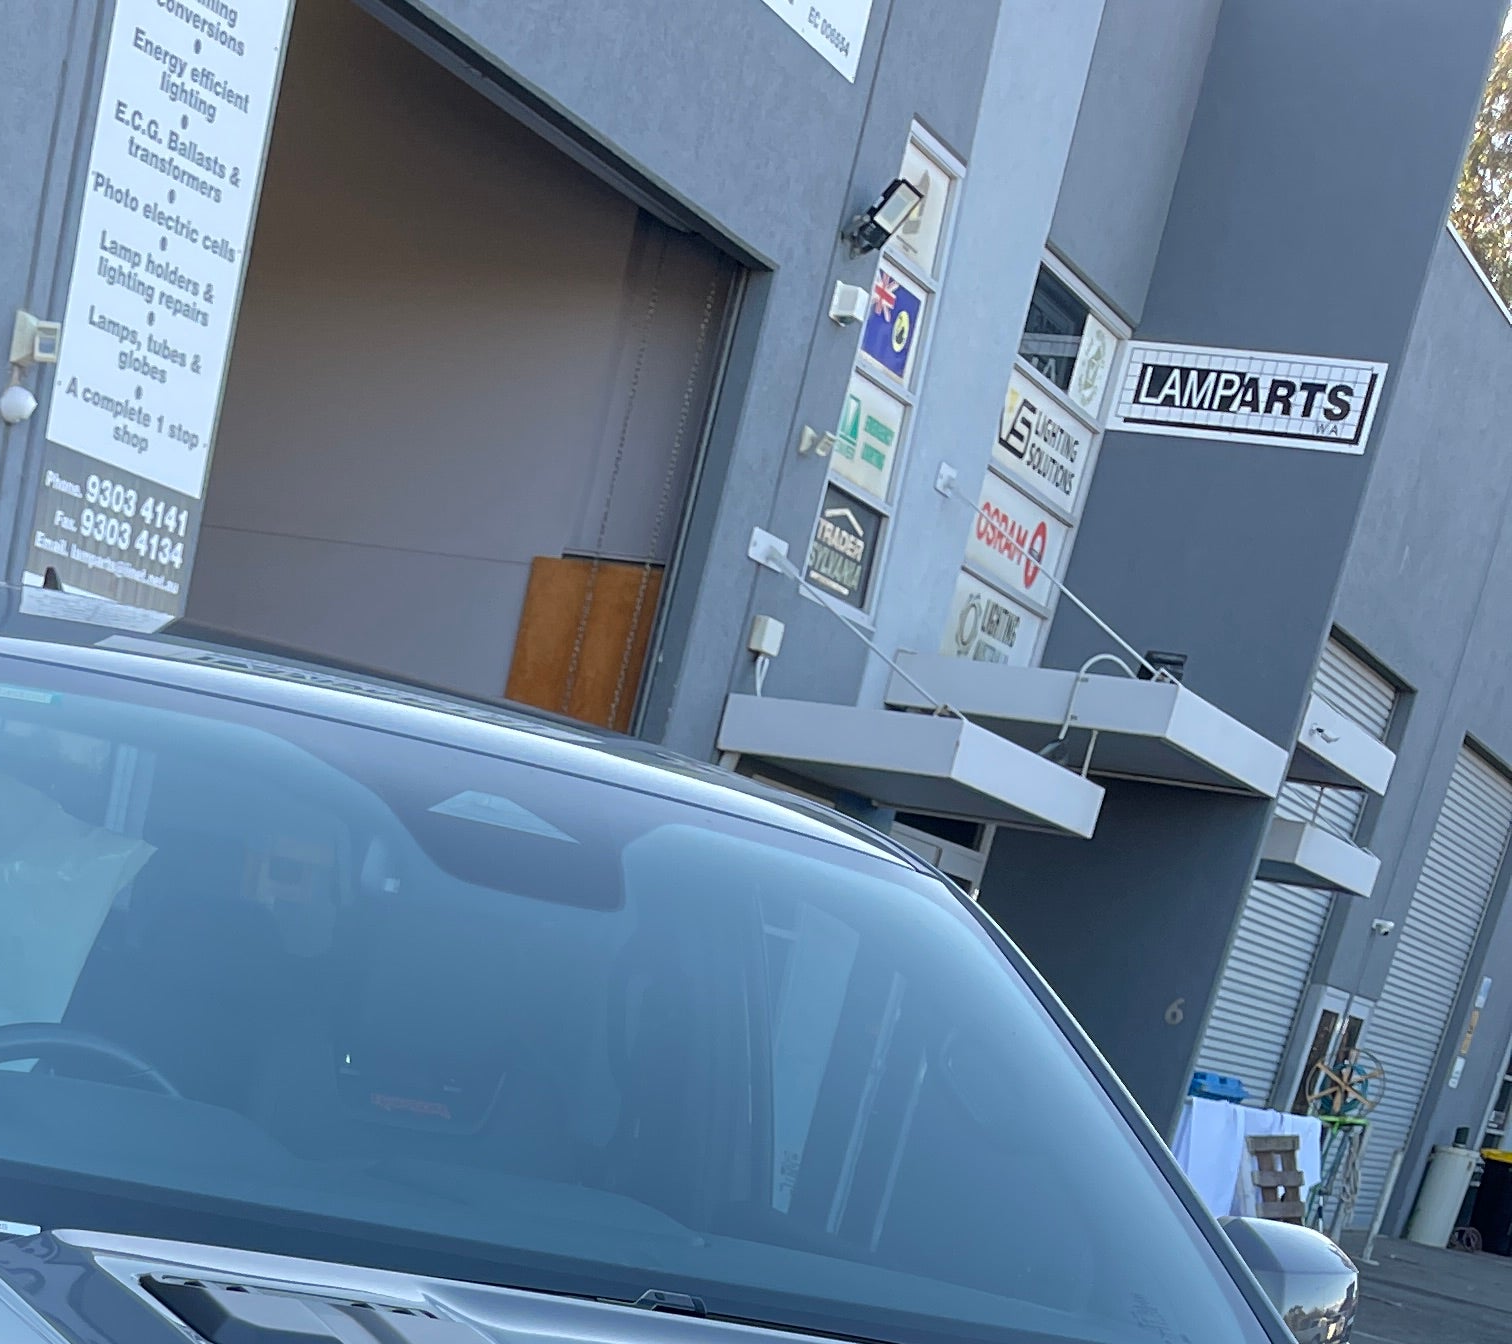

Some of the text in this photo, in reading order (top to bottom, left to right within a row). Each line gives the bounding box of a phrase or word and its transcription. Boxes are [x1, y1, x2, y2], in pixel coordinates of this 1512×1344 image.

[133, 27, 250, 114] Energy efficient
[159, 71, 217, 123] lighting
[114, 100, 241, 188] E.C.G. Ballasts &
[128, 136, 223, 203] transformers
[93, 173, 236, 263] Photo electric cells
[97, 255, 209, 327] lighting repairs
[99, 230, 214, 304] Lamp holders &
[88, 305, 202, 374] Lamps, tubes &
[118, 351, 168, 384] globes
[66, 376, 199, 450] A complete 1 stop
[1139, 364, 1355, 421] LAMPARTS
[113, 425, 149, 454] shop
[1034, 410, 1080, 463] LIGHTING
[1315, 422, 1339, 436] WA
[1026, 442, 1075, 496] SOLUTIONS
[86, 474, 138, 517] 9303
[140, 497, 188, 537] 4141
[975, 501, 1029, 566] OSRAM
[80, 508, 132, 550] 9303
[135, 530, 184, 569] 4134
[816, 518, 865, 563] TRADER
[1164, 997, 1185, 1026] 6
